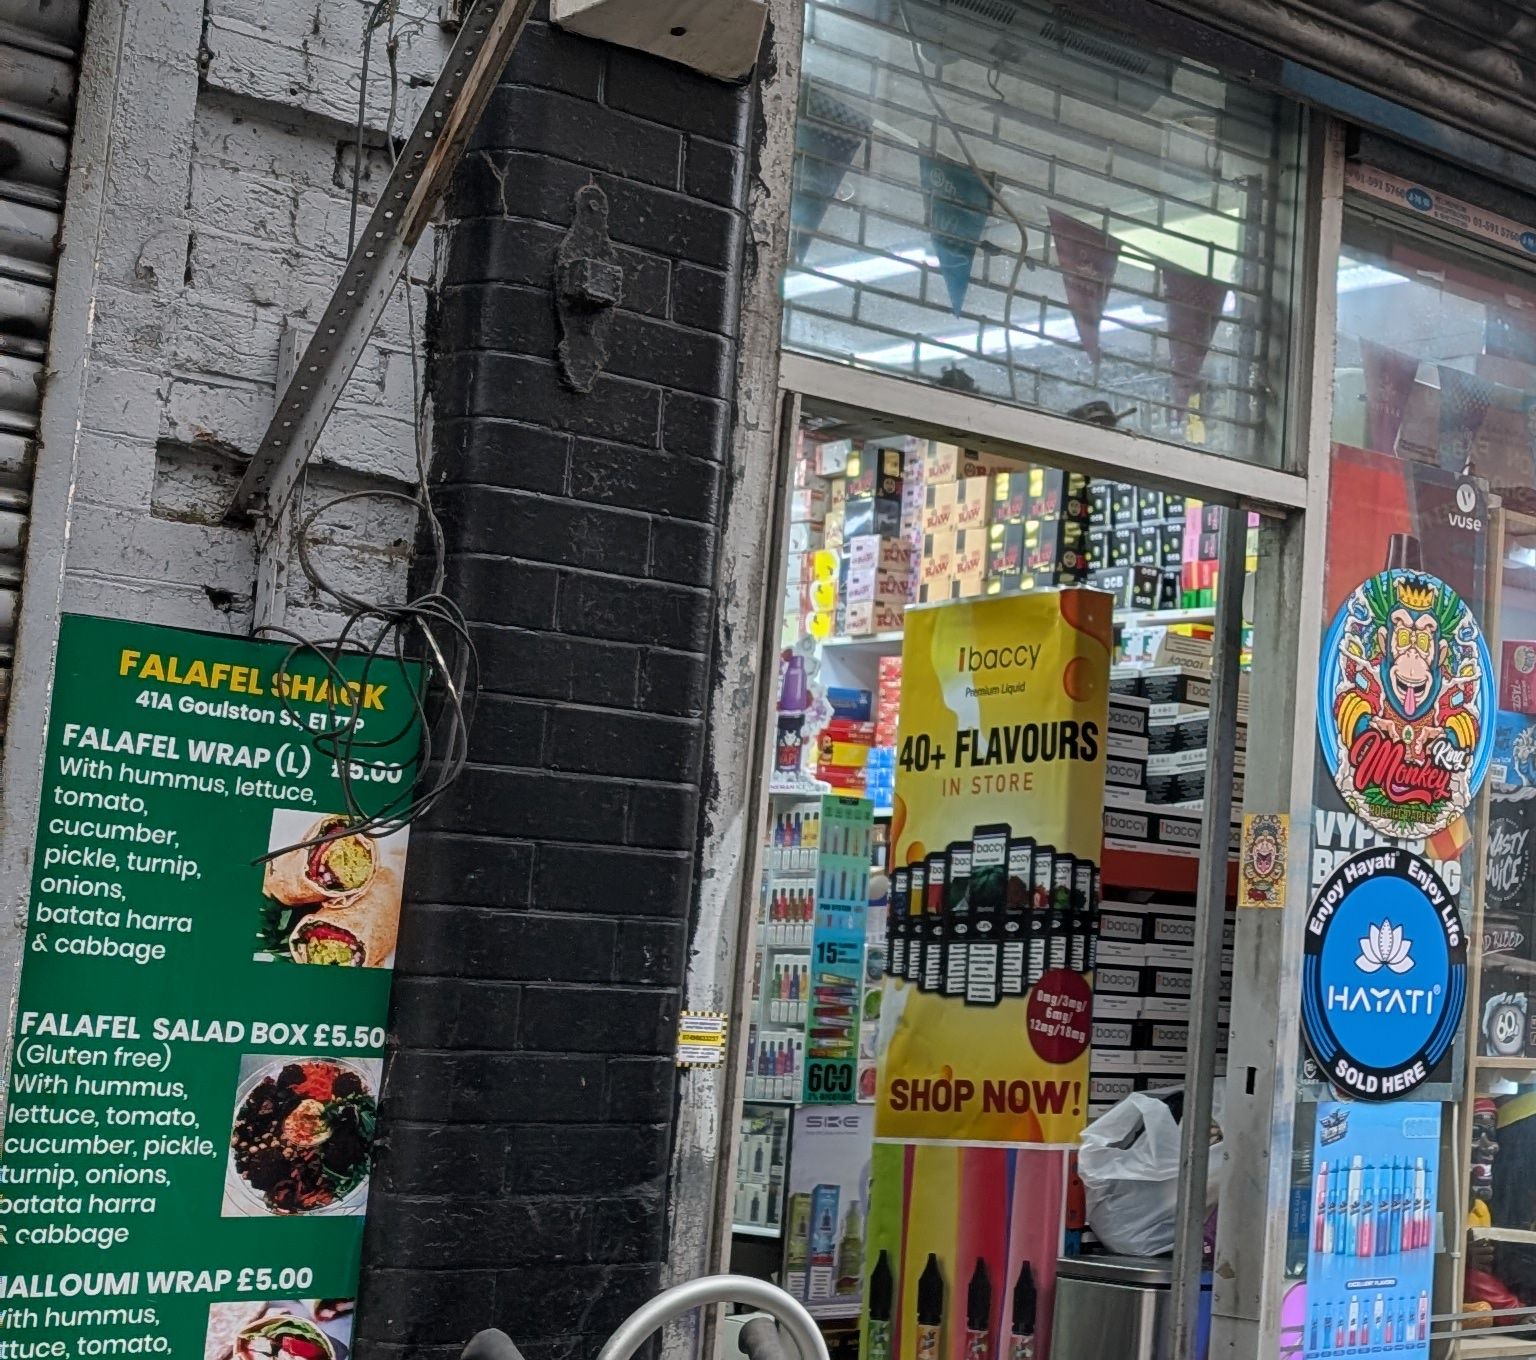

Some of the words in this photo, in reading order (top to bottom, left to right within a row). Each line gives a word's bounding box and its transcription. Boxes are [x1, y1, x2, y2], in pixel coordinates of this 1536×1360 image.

[928, 511, 950, 528] RAW
[958, 508, 980, 525] RAW
[925, 561, 949, 579] RAW
[957, 558, 980, 574] RAW
[1104, 575, 1123, 589] OCB
[119, 648, 264, 696] FALAFEL
[271, 671, 388, 711] SHACK
[965, 686, 1000, 698] Premium
[1001, 681, 1026, 696] Liquid
[135, 689, 173, 711] 41A
[178, 696, 275, 725] Goulston
[61, 723, 181, 761] FALAFEL
[188, 738, 271, 770] WRAP
[275, 742, 312, 779] (L)
[900, 732, 946, 774] 40+
[954, 720, 1099, 768] FLAVOURS
[1432, 739, 1470, 772] King
[58, 755, 114, 780] With
[118, 763, 230, 797] hummus,
[235, 776, 318, 806] lettuce,
[942, 774, 961, 797] IN
[971, 771, 1034, 795] STORE
[53, 785, 150, 817] tomato,
[48, 817, 180, 850] cucumber,
[43, 843, 121, 872] pickle,
[126, 852, 202, 882] turnip,
[40, 875, 127, 903] onions,
[1308, 880, 1345, 936] Enjoy
[1346, 852, 1397, 884] Hayati
[1407, 859, 1446, 904] Enjoy
[1441, 904, 1461, 948] Life
[35, 902, 120, 929] batata
[125, 908, 193, 934] harra
[31, 932, 49, 953] &
[54, 934, 167, 965] cabbage
[816, 941, 836, 965] 15
[20, 1010, 141, 1040] FALAFEL
[152, 1016, 244, 1044] SALAD
[249, 1021, 307, 1047] BOX
[313, 1024, 386, 1049] £5.50
[15, 1038, 108, 1068] (Gluten
[113, 1042, 172, 1072] free)
[13, 1073, 69, 1096] With
[74, 1075, 189, 1102] hummus,
[1334, 1058, 1378, 1093] SOLD
[1381, 1060, 1427, 1094] HERE
[889, 1076, 973, 1113] SHOP
[983, 1077, 1082, 1116] NOW!
[8, 1104, 100, 1128] lettuce,
[105, 1106, 200, 1130] tomato,
[3, 1134, 138, 1159] cucumber,
[143, 1136, 218, 1161] pickle,
[0, 1163, 79, 1190] turnip,
[85, 1166, 172, 1187] onions,
[88, 1193, 156, 1214] harra
[15, 1224, 129, 1249] cabbage
[147, 1270, 233, 1296] WRAP
[236, 1266, 314, 1293] £5.00
[44, 1306, 160, 1328] hummus,
[77, 1334, 172, 1357] tomato,
